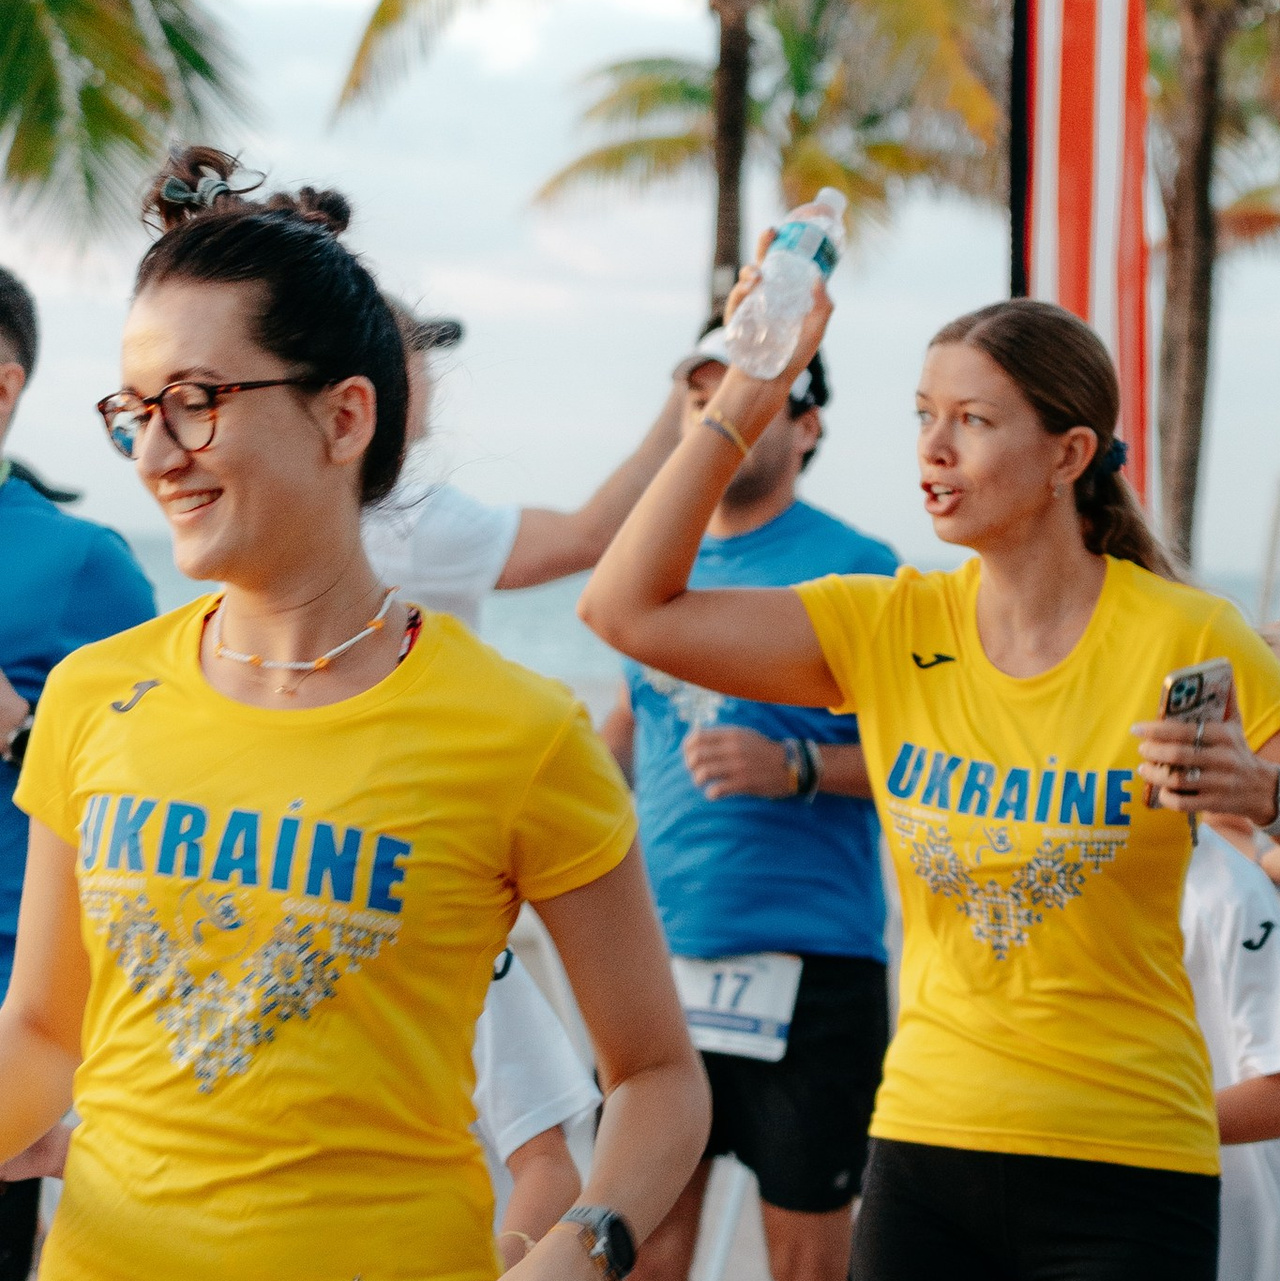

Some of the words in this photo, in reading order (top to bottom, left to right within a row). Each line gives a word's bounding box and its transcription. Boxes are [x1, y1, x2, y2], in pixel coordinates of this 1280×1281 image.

[886, 741, 1133, 826] UKRAINE
[80, 793, 413, 915] UKRAINE
[710, 972, 752, 1008] 17
